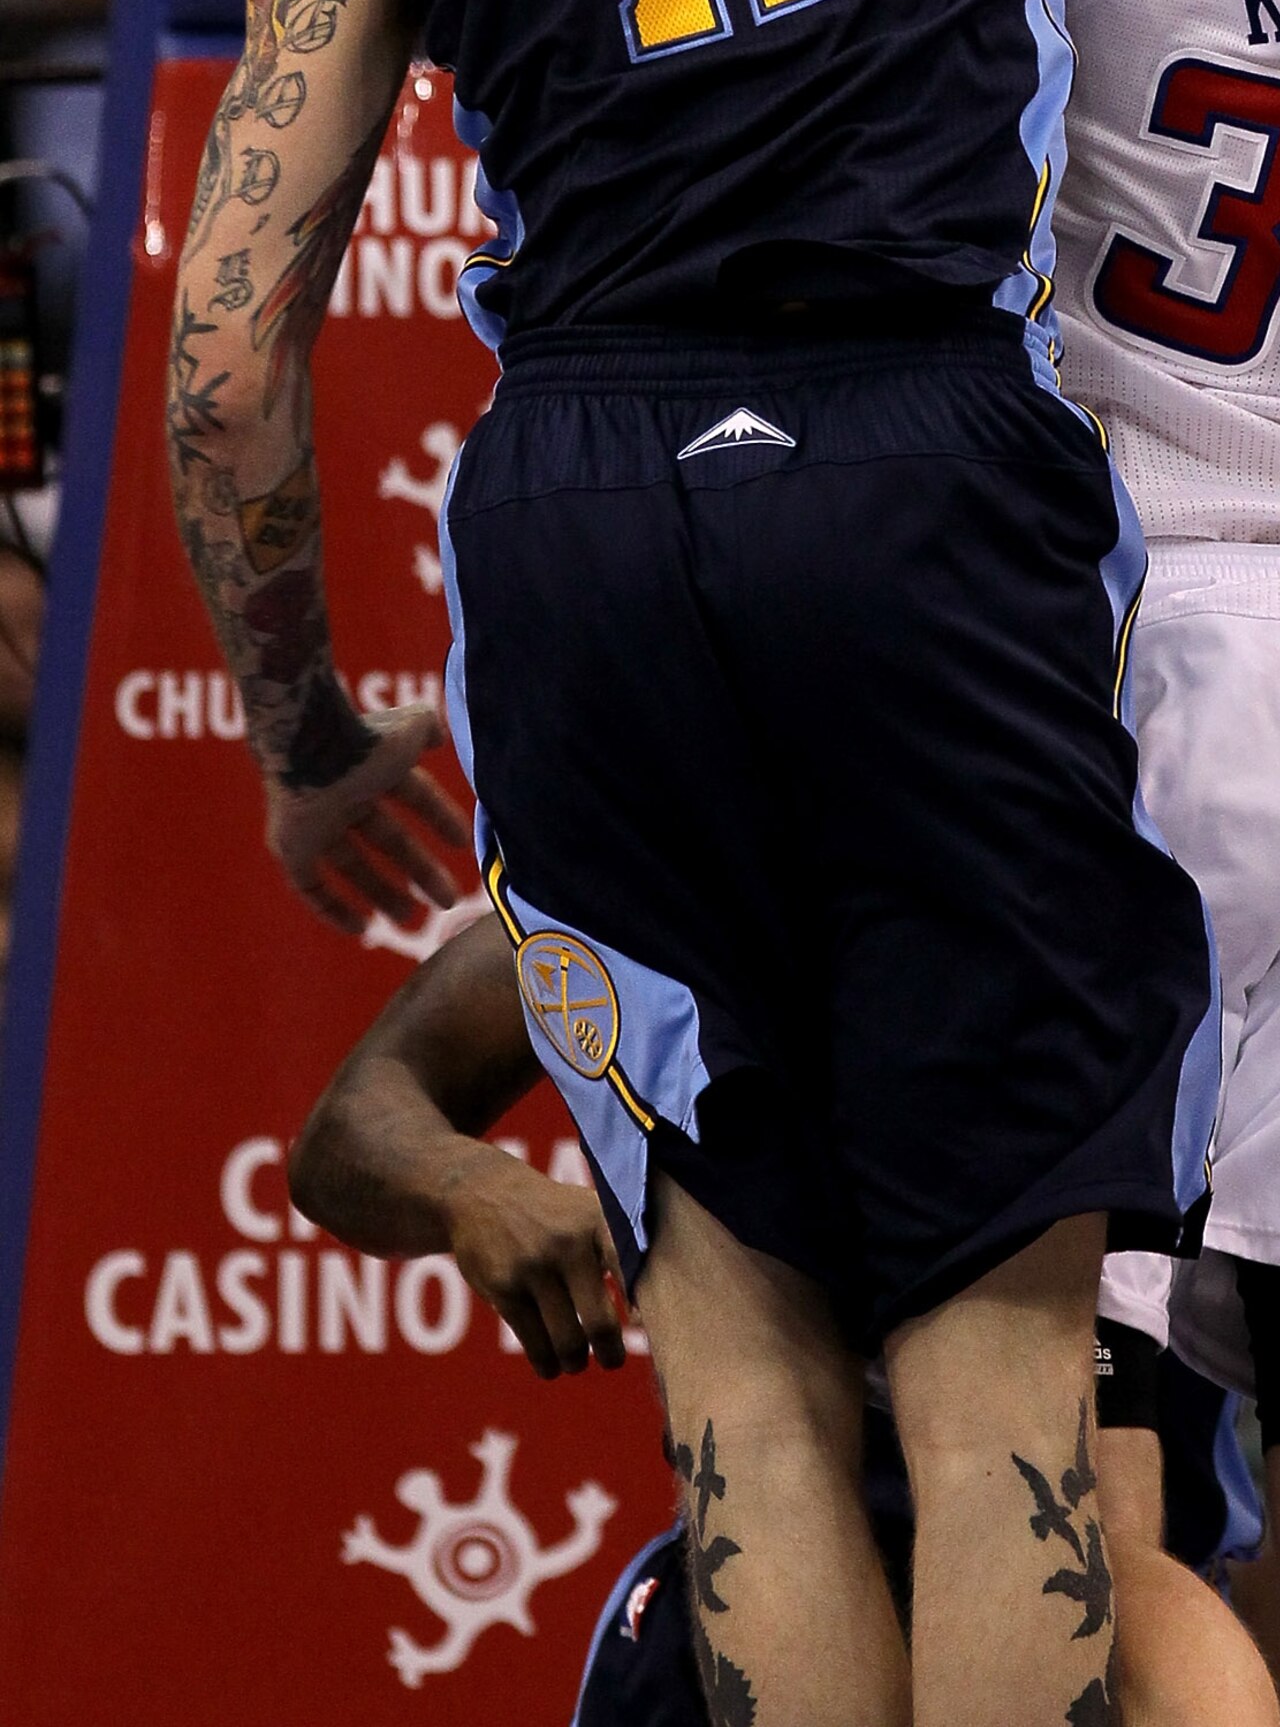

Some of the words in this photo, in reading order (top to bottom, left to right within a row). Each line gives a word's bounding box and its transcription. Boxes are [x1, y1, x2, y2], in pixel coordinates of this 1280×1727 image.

[329, 239, 470, 319] INO
[114, 669, 442, 740] CHUSH
[84, 1249, 472, 1356] CASINO
